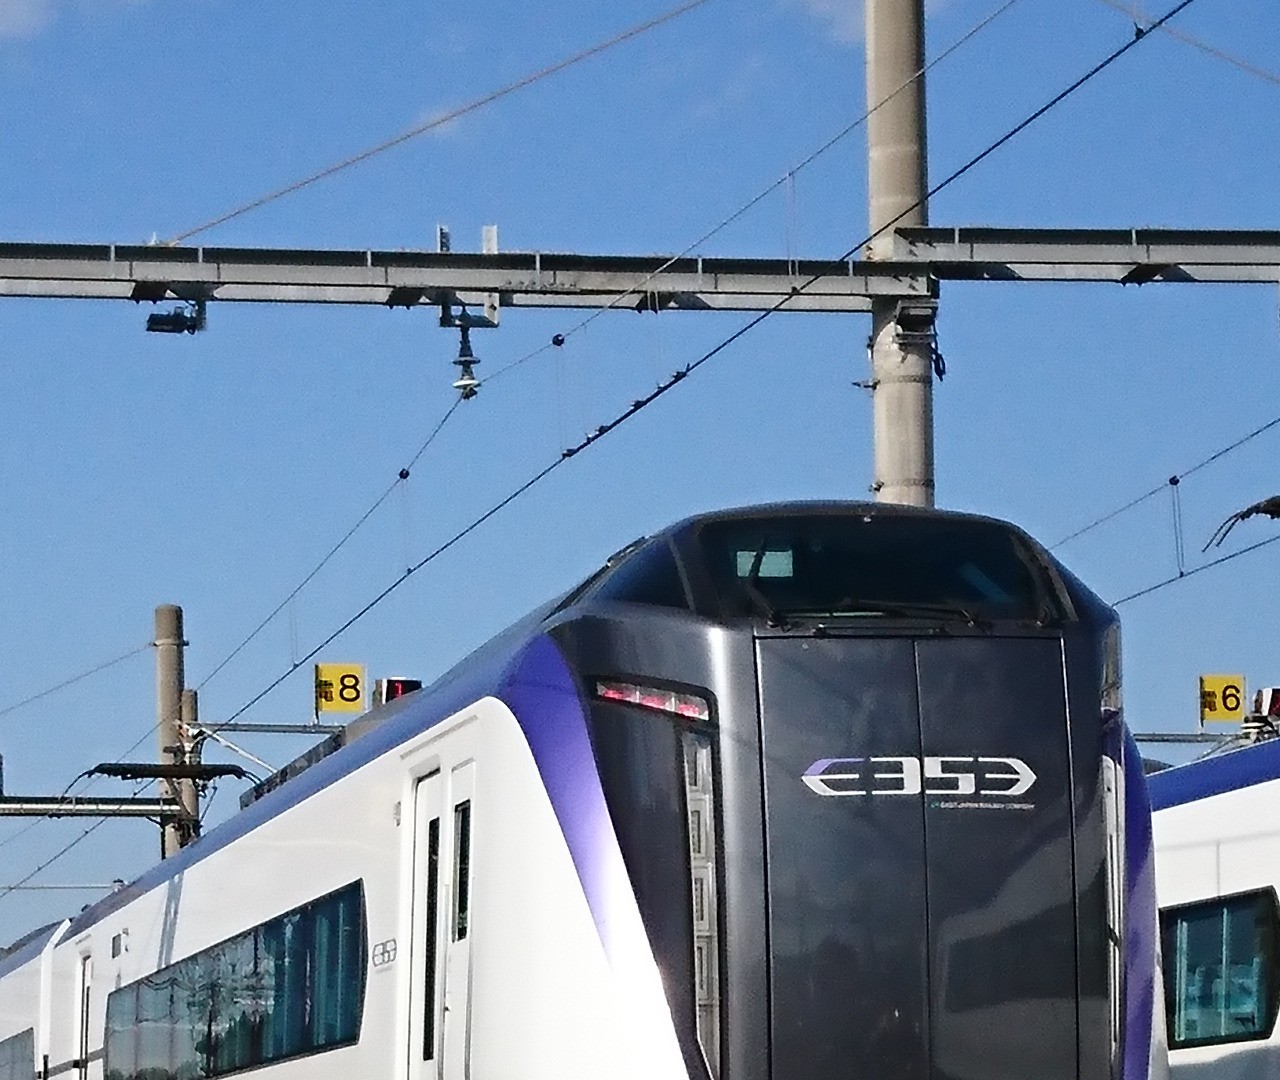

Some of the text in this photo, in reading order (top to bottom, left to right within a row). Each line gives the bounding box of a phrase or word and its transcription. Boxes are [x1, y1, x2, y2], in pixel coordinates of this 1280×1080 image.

[339, 673, 361, 703] 8
[1221, 684, 1241, 712] 6
[800, 756, 1038, 796] E353
